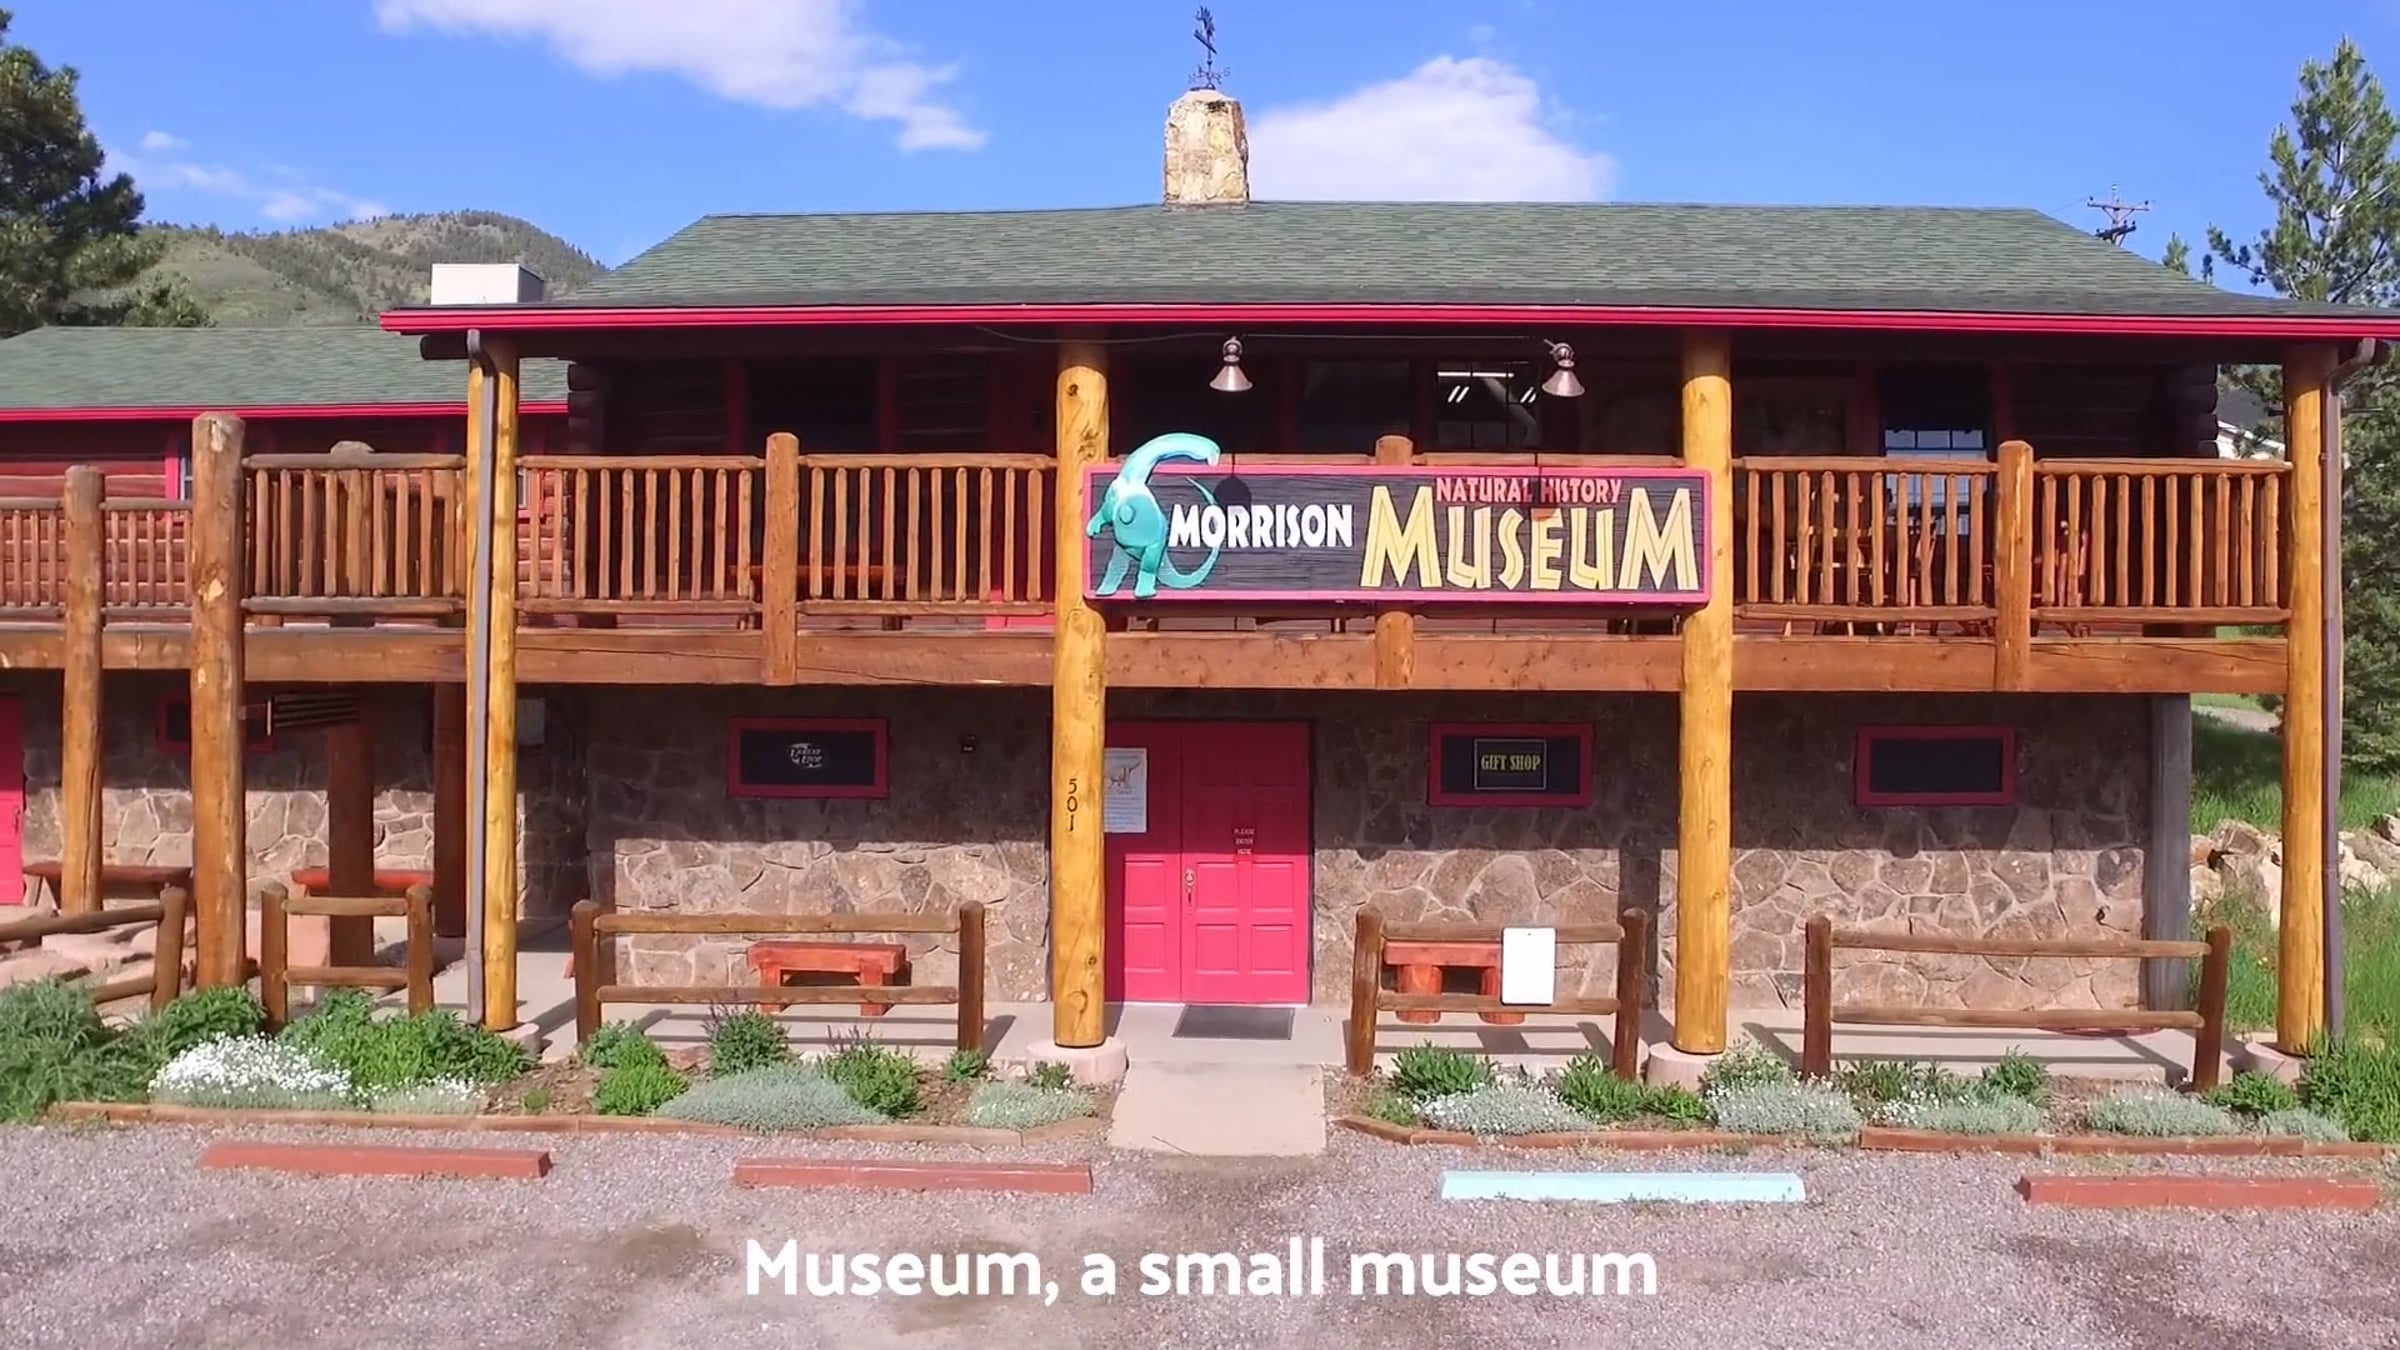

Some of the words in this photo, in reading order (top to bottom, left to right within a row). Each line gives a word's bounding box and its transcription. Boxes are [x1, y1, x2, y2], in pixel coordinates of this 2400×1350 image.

[1436, 477, 1533, 502] NATURAL
[1540, 478, 1622, 503] HISTORY
[1168, 503, 1354, 548] MORRISON
[1360, 485, 1699, 591] MUSEUM
[1480, 754, 1508, 771] GIFT
[1509, 754, 1541, 771] SHOP
[1066, 778, 1079, 833] 501
